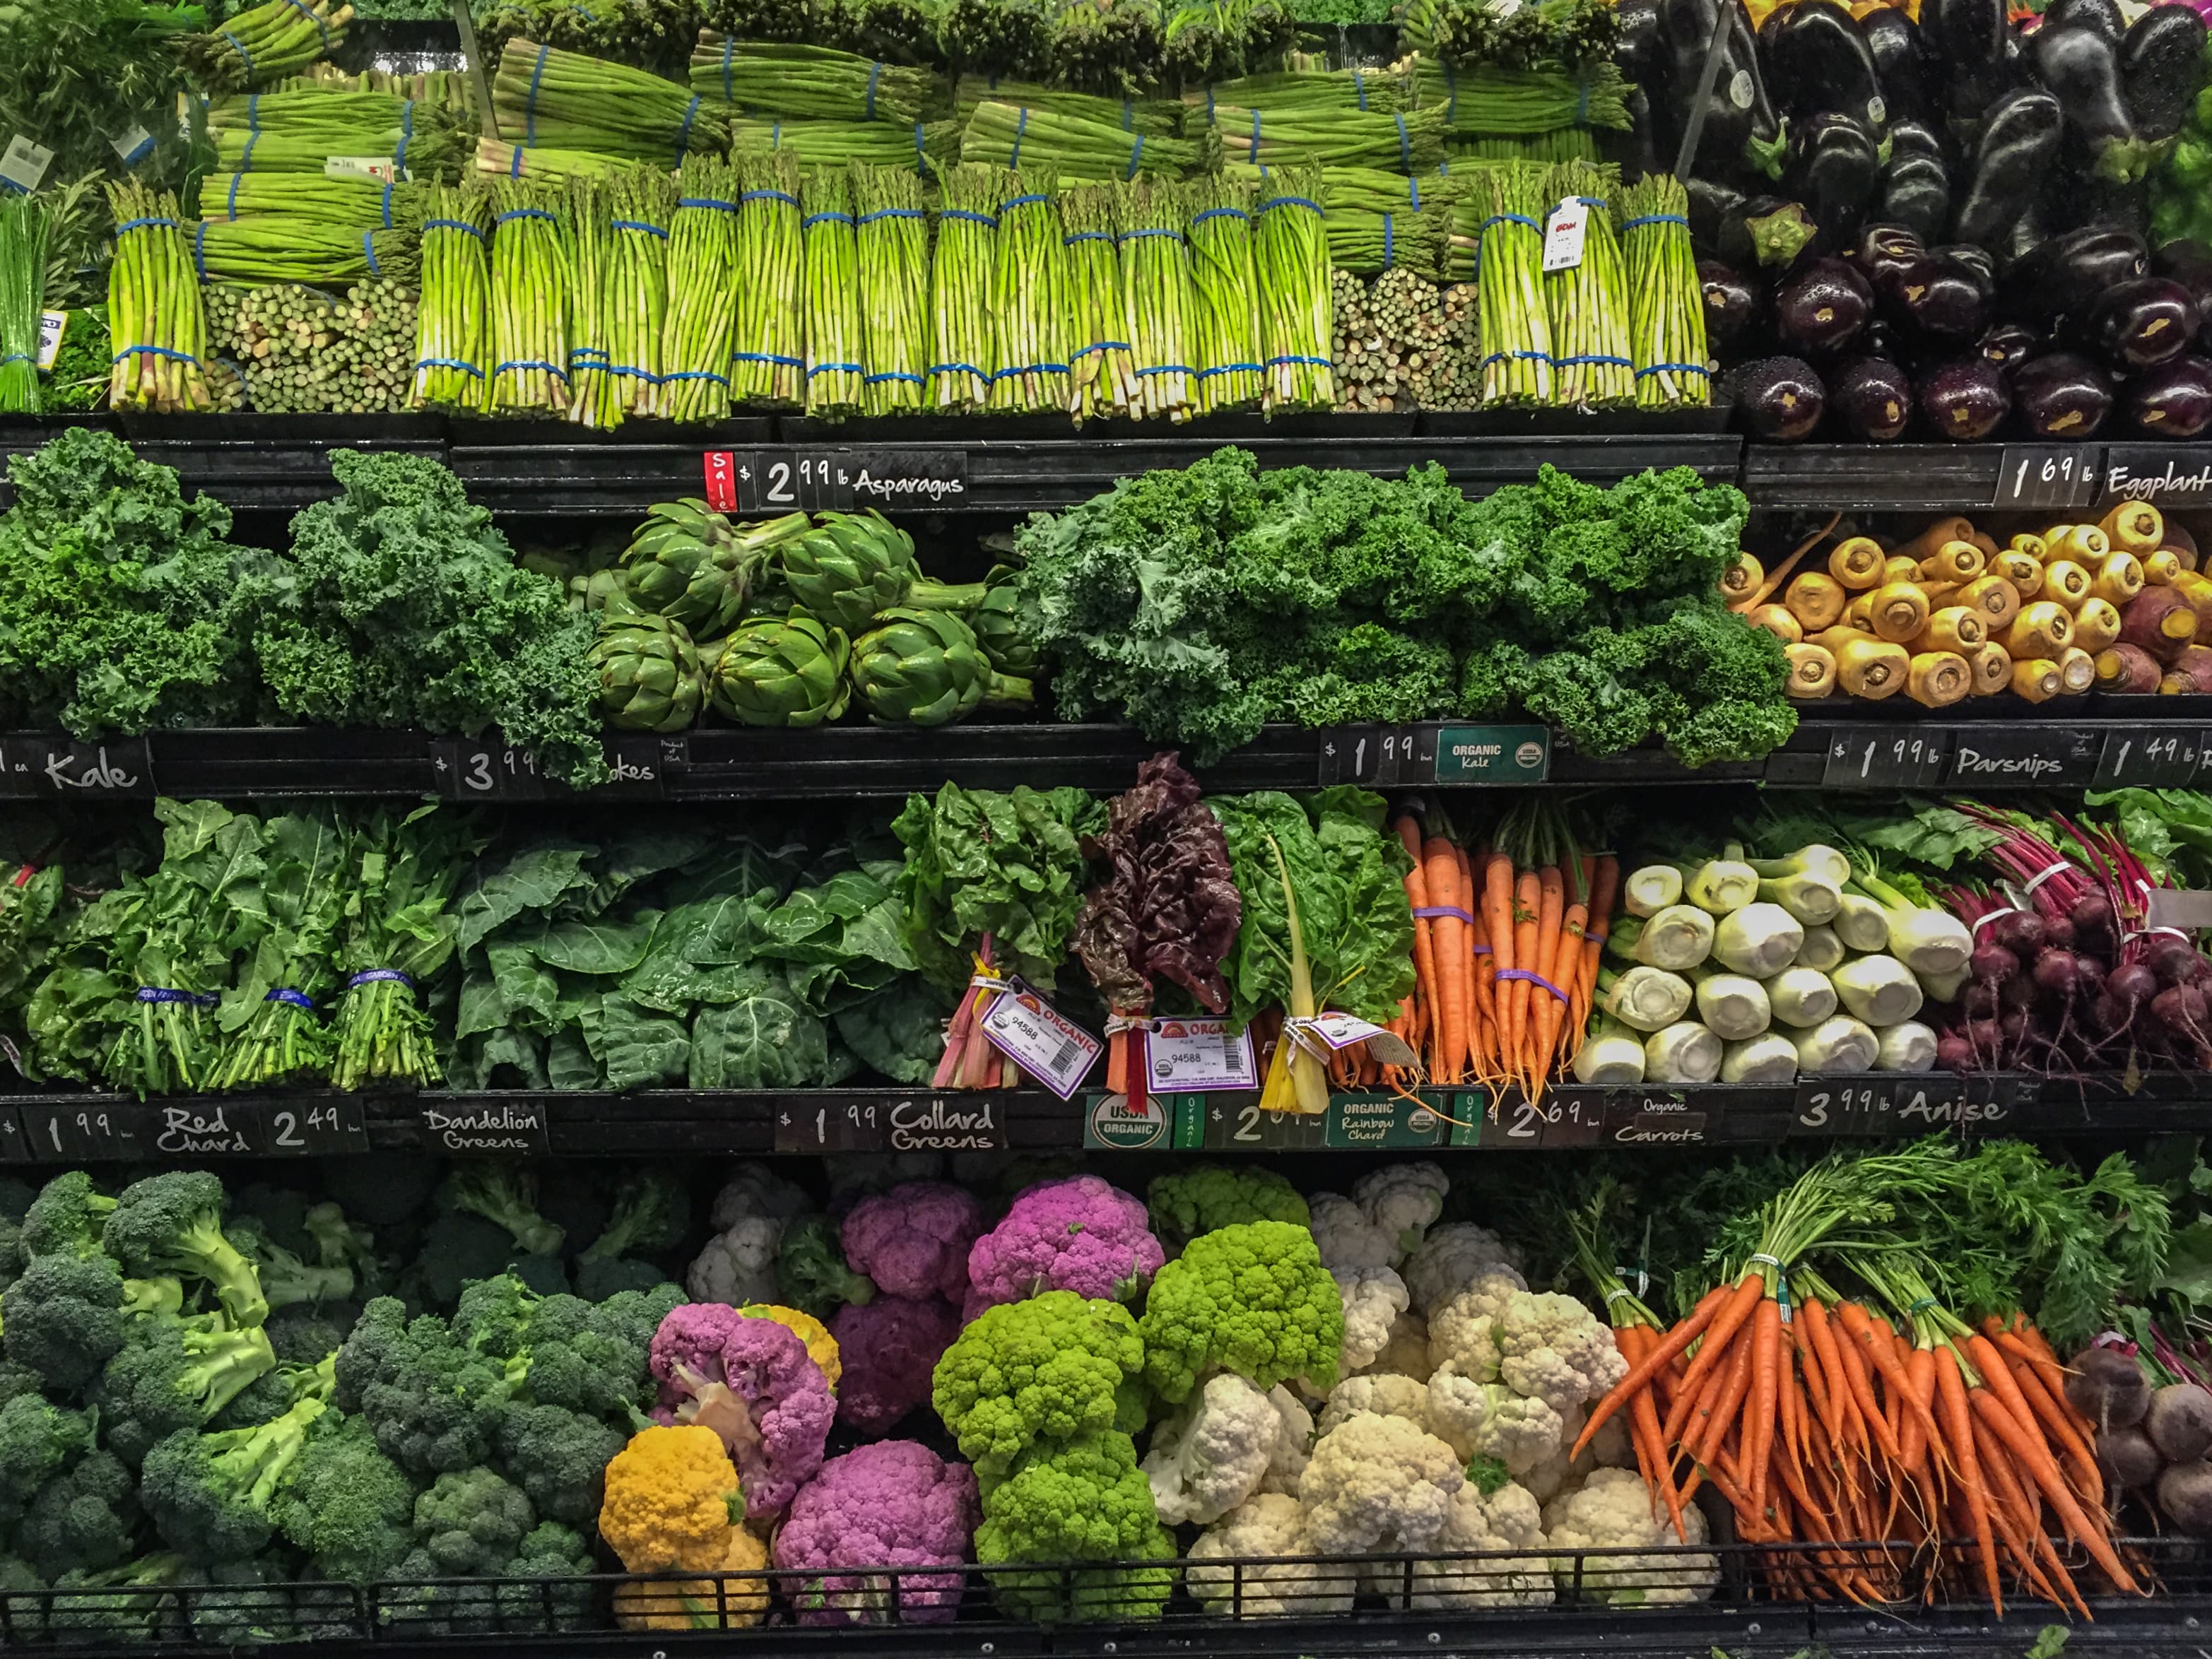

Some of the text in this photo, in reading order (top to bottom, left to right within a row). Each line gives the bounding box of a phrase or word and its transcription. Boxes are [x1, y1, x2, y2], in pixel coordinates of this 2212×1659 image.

[712, 453, 728, 509] Sale
[853, 470, 964, 501] Asparagus
[2109, 461, 2212, 500] Eggplant
[1452, 745, 1502, 757] ORGANIC
[1462, 756, 1489, 768] Kale
[45, 747, 137, 789] Kale
[1958, 748, 2063, 779] Parsnips
[1011, 1016, 1039, 1041] 94588
[1043, 1009, 1096, 1054] ORGANIC
[1190, 1022, 1228, 1035] ORGA
[1171, 1053, 1201, 1063] 94588
[890, 1100, 994, 1130] Collard
[1343, 1103, 1394, 1115] ORGANIC
[1643, 1098, 1688, 1112] Organic
[1898, 1091, 2008, 1122] Anise
[162, 1106, 230, 1133] Red
[423, 1106, 539, 1131] Dandelion
[1103, 1123, 1153, 1135] ORGANIC
[1341, 1116, 1394, 1130] Rainbow
[1462, 1095, 1474, 1145] Orgnic
[156, 1130, 251, 1152] Chard
[442, 1130, 529, 1150] Greens
[890, 1128, 994, 1150] Greens
[1348, 1129, 1385, 1140] Chard
[1615, 1126, 1704, 1142] Carrots
